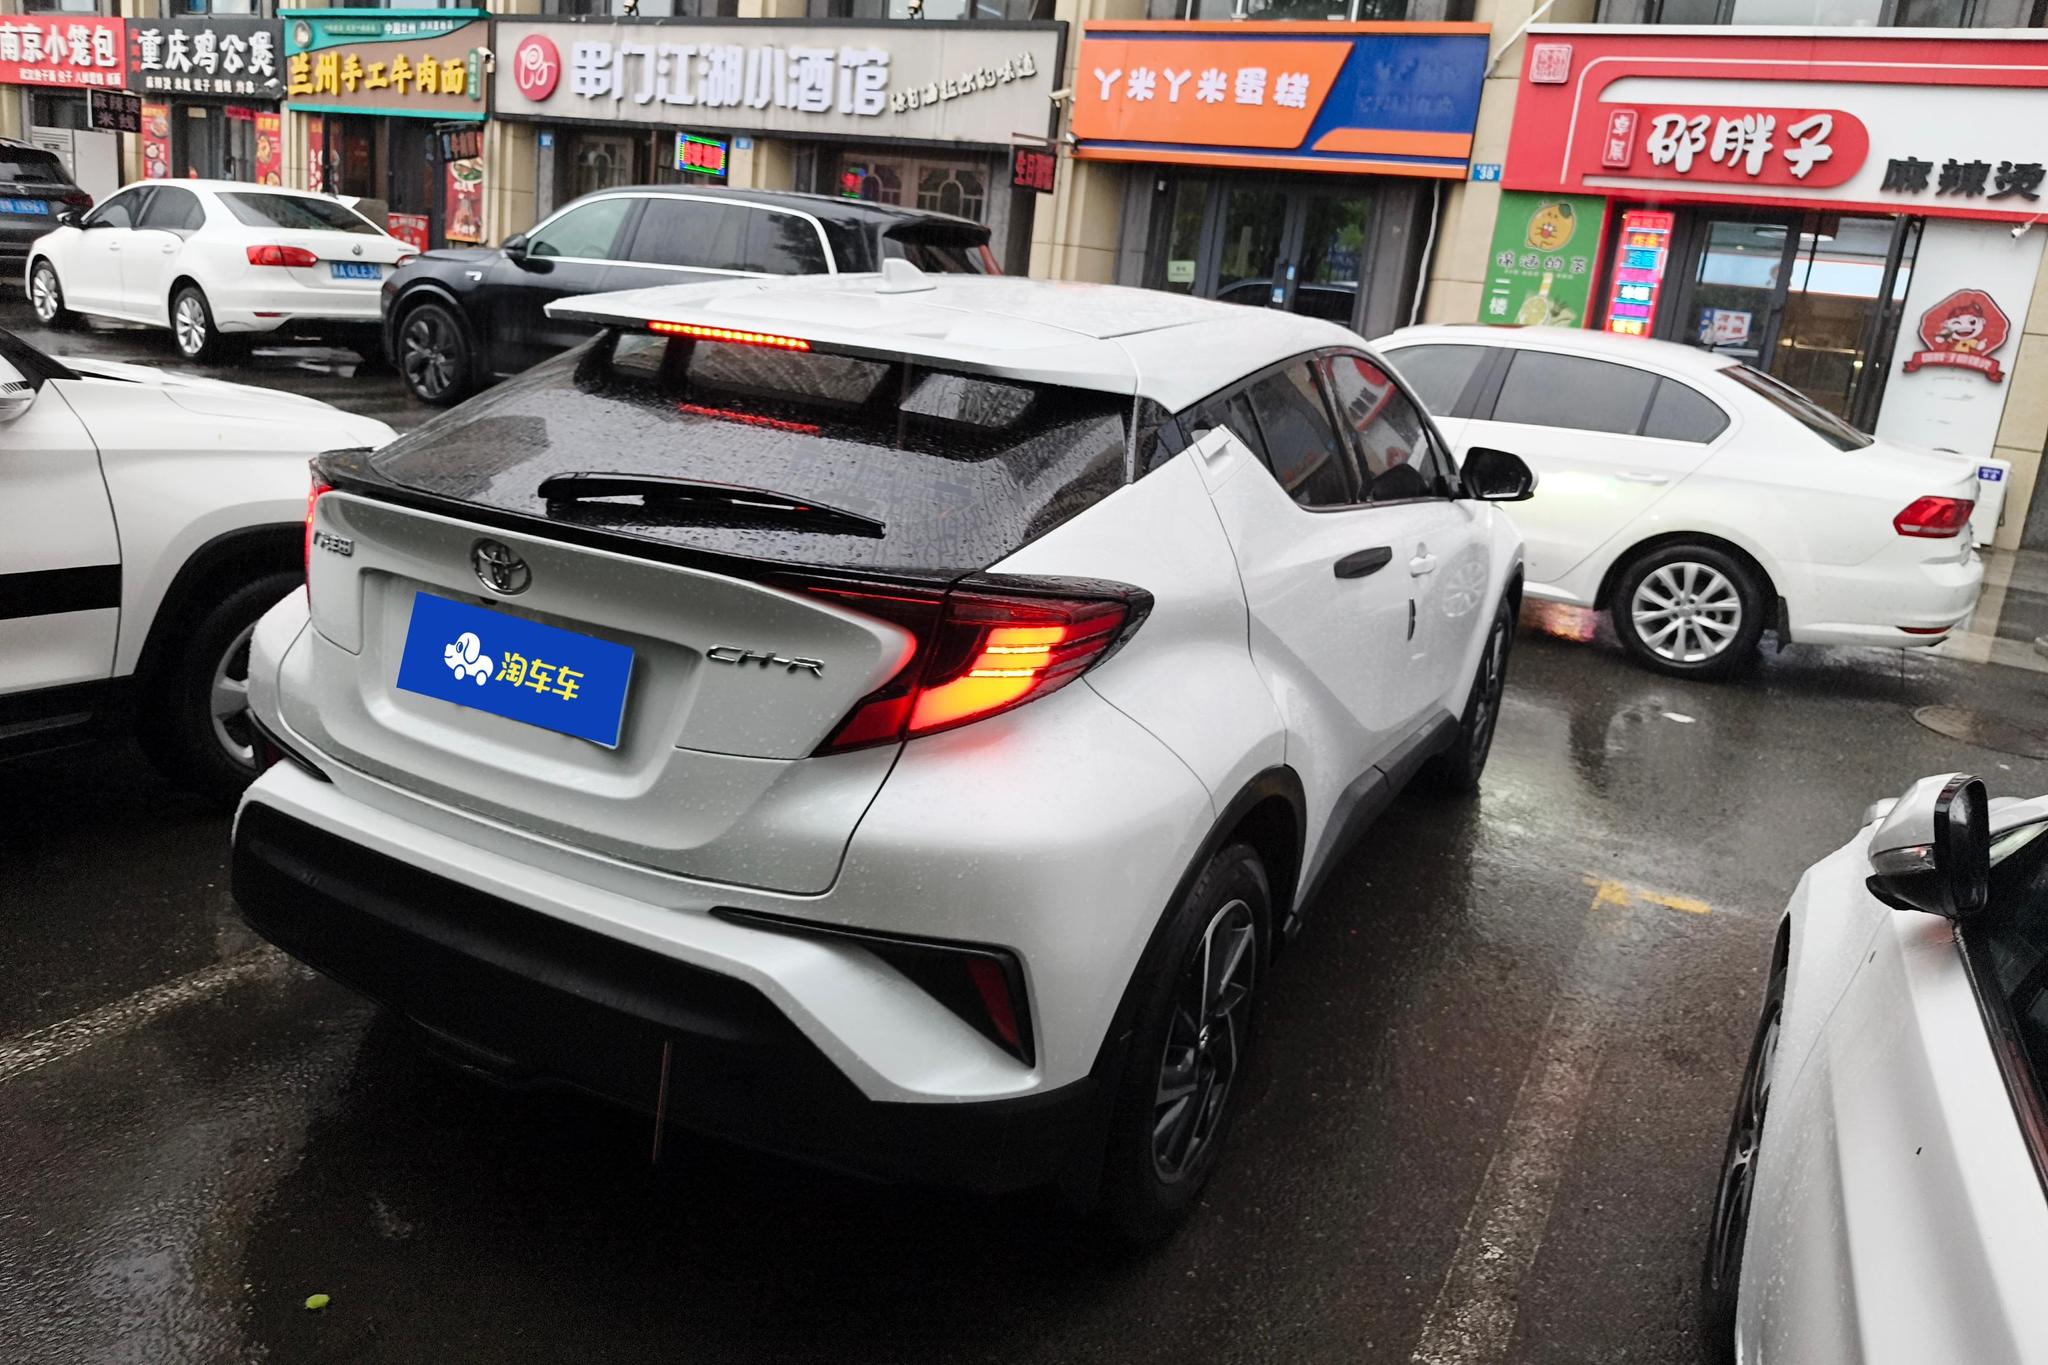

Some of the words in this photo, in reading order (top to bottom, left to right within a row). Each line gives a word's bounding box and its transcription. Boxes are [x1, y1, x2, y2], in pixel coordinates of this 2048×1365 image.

[0, 21, 118, 67] 南京小笼包
[137, 28, 276, 77] 重庆鸡公煲
[288, 51, 466, 95] 兰州手工牛肉面
[570, 40, 891, 116] 串门江湖小酒馆
[1646, 113, 1834, 178] 邵胖子
[1880, 157, 2047, 201] 麻辣烫
